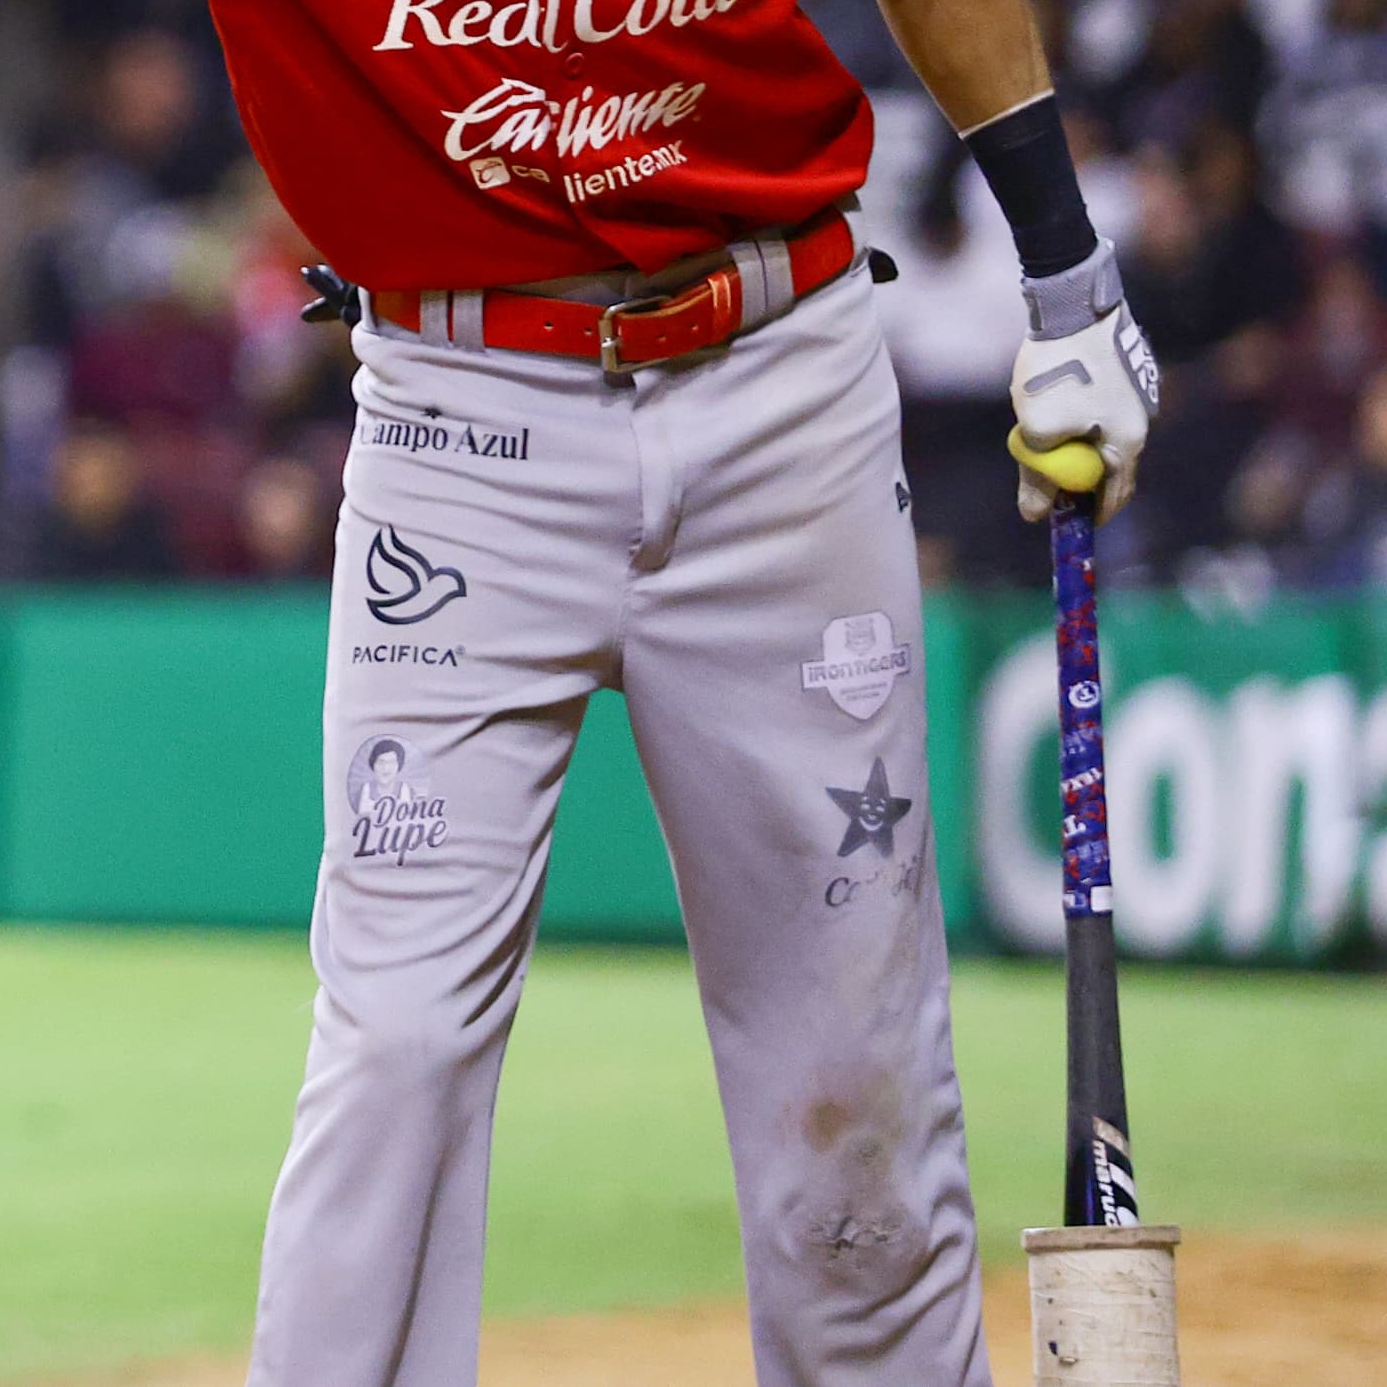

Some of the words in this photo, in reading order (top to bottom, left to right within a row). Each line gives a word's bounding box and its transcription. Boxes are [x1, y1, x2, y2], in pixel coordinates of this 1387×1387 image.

[453, 422, 530, 461] Azul
[352, 645, 459, 668] PACIFICA
[351, 814, 448, 867] Lupe
